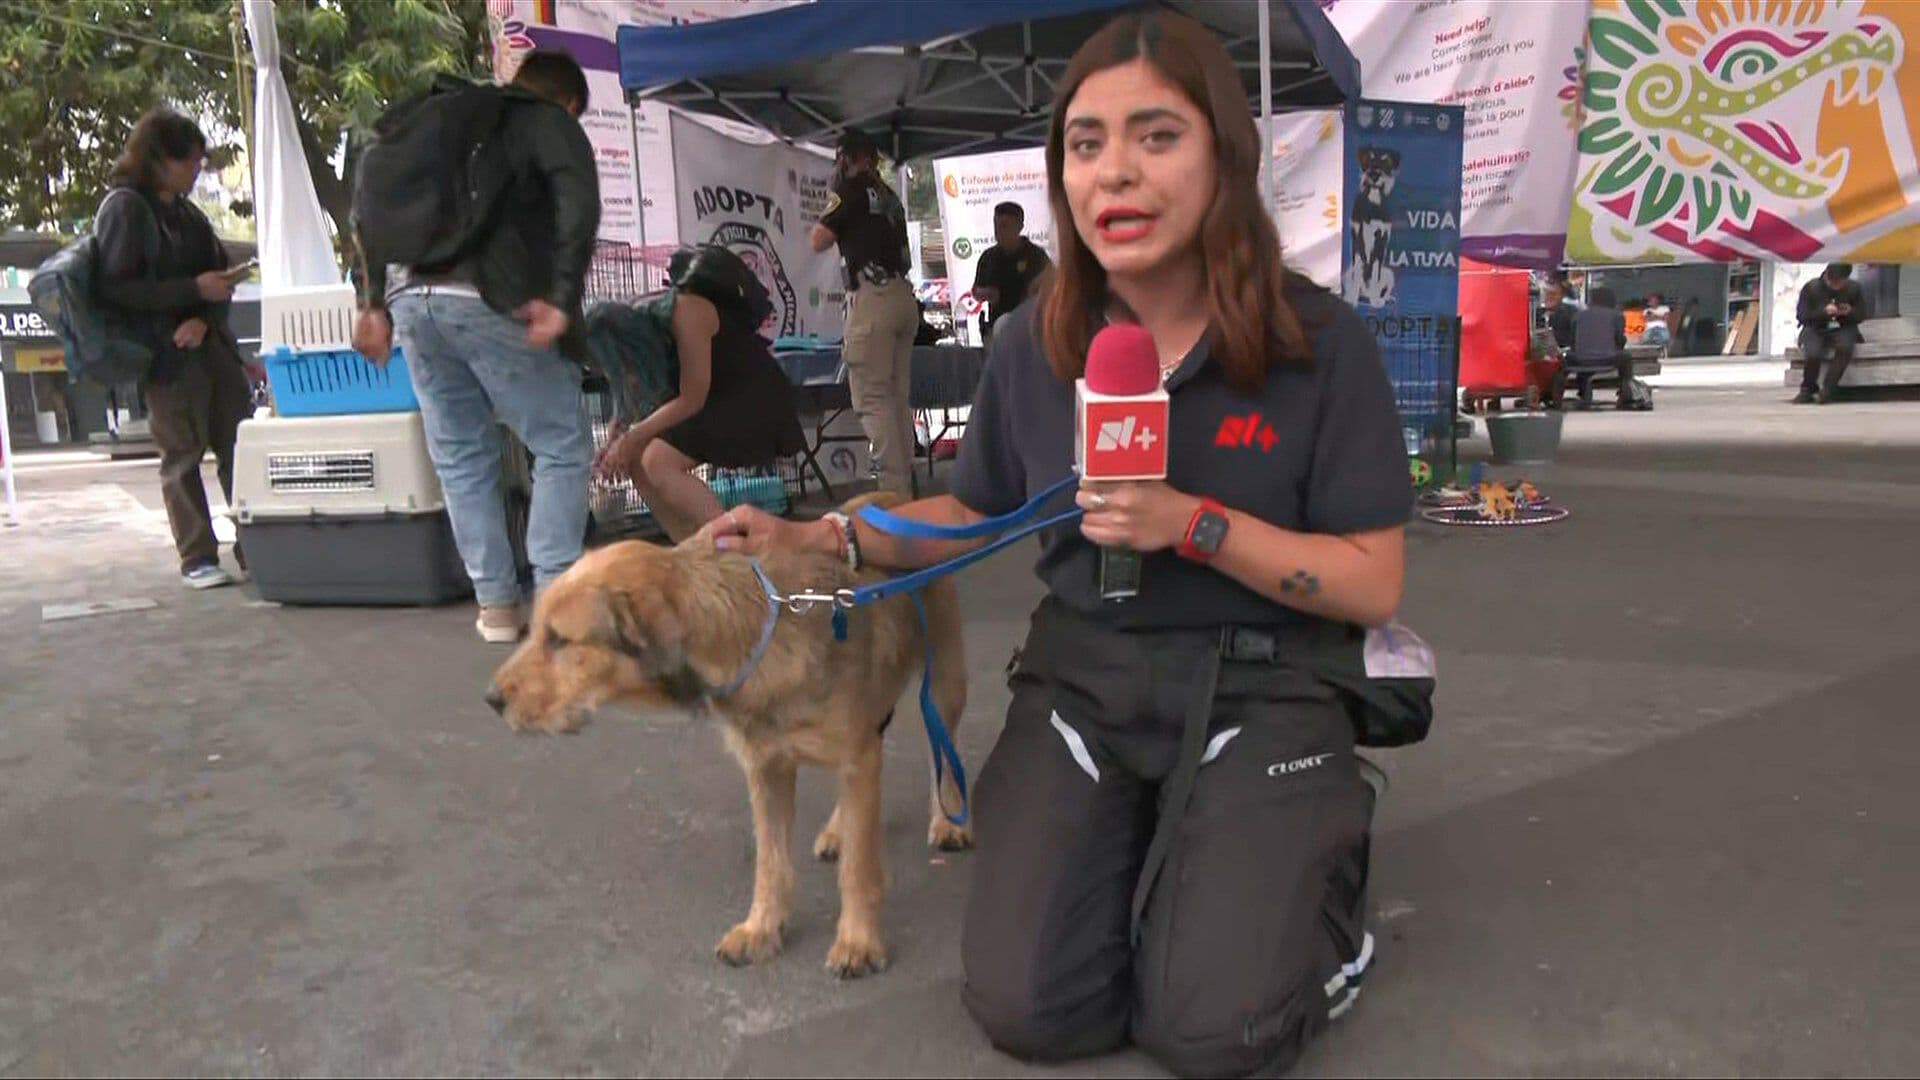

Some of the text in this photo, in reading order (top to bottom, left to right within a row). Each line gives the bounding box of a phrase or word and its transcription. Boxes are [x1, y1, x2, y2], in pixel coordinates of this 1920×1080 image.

[1435, 16, 1492, 44] Need help?
[1394, 71, 1411, 84] We
[1413, 66, 1431, 79] are
[1455, 52, 1468, 64] to
[1513, 39, 1535, 54] you
[693, 185, 785, 235] ADOPTA
[1406, 210, 1457, 230] VIDA
[1390, 250, 1456, 267] LA TUYA
[1365, 314, 1449, 340] DOPTA
